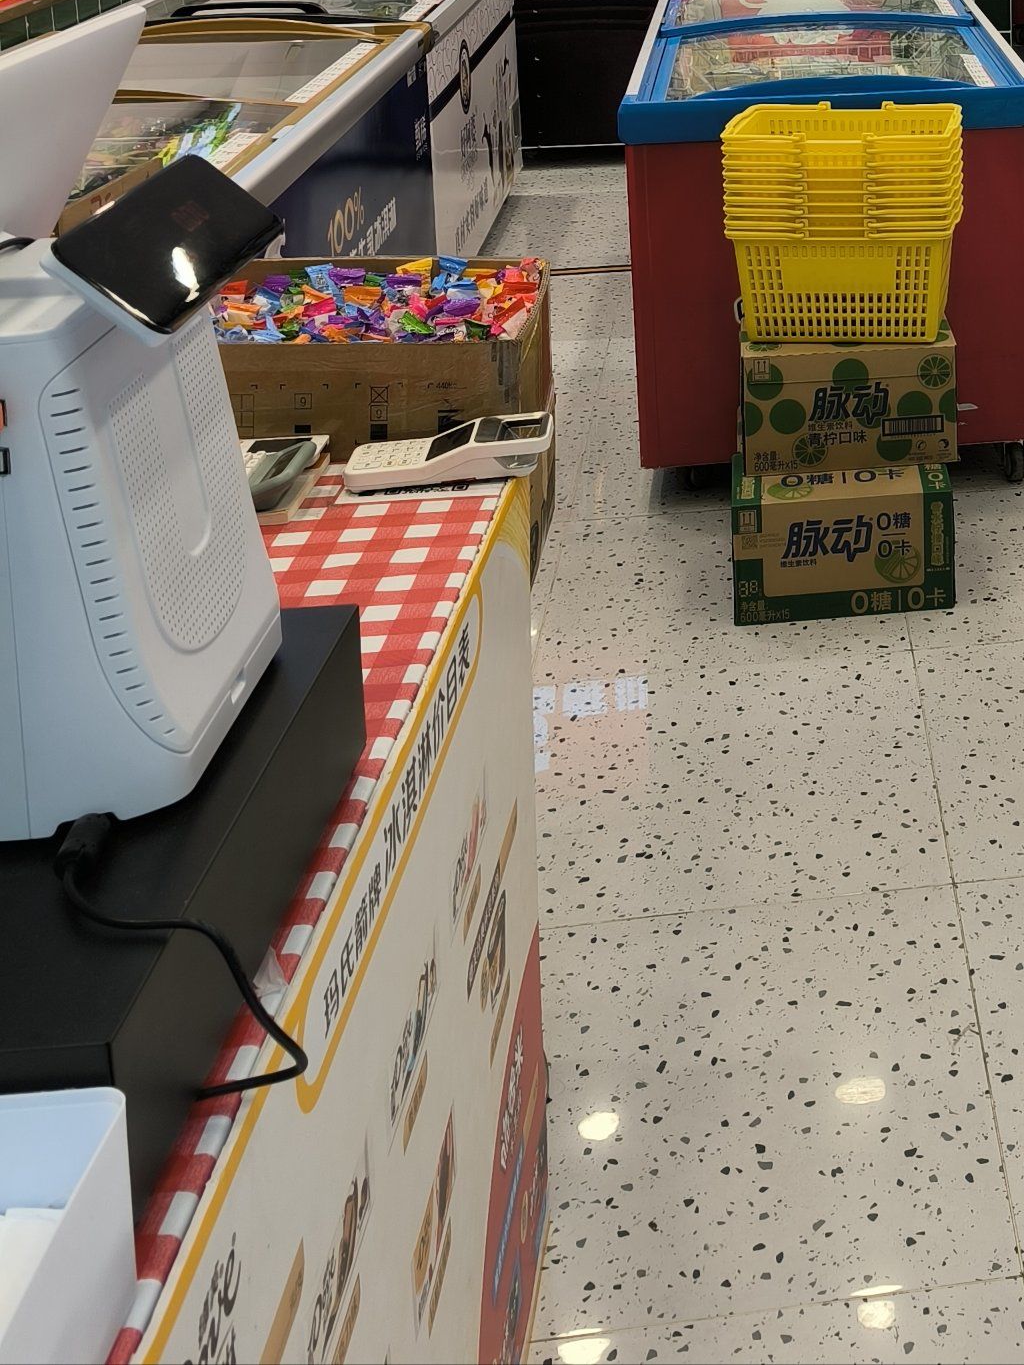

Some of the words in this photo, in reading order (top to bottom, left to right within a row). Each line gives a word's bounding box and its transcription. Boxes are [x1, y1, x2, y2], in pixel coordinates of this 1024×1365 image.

[808, 381, 890, 426] 脉动
[807, 421, 853, 432] 维生素饮料
[807, 430, 868, 447] 青柠口味
[781, 515, 874, 563] 脉动
[323, 861, 382, 1040] 玛氏箭牌
[384, 622, 472, 890] 冰淇淋价目表
